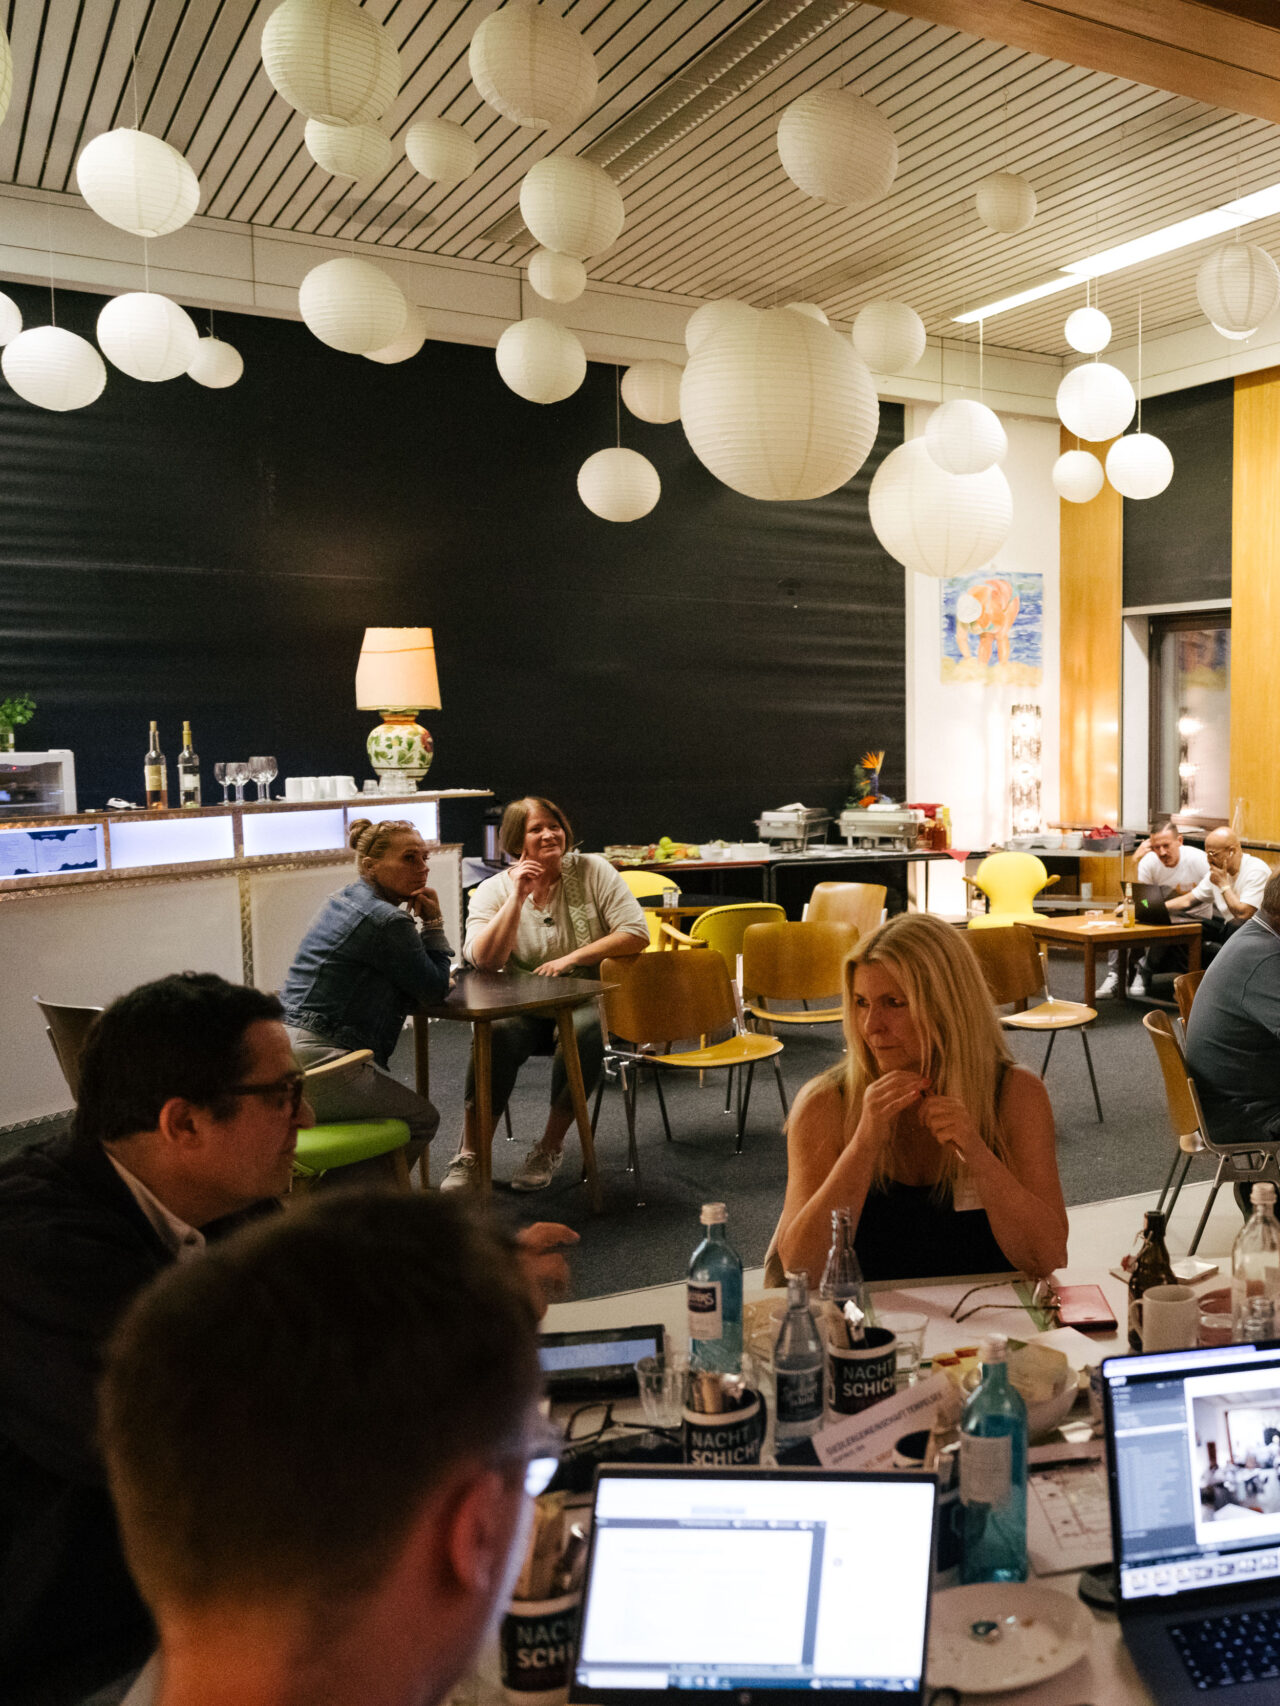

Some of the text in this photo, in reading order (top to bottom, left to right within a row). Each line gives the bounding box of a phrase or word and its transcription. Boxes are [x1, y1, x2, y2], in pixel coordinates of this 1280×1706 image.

[842, 1360, 895, 1380] NACHT
[842, 1376, 896, 1398] SCHIC
[691, 1425, 750, 1448] NACHT
[517, 1621, 566, 1646] NAC
[516, 1642, 575, 1669] SCHI
